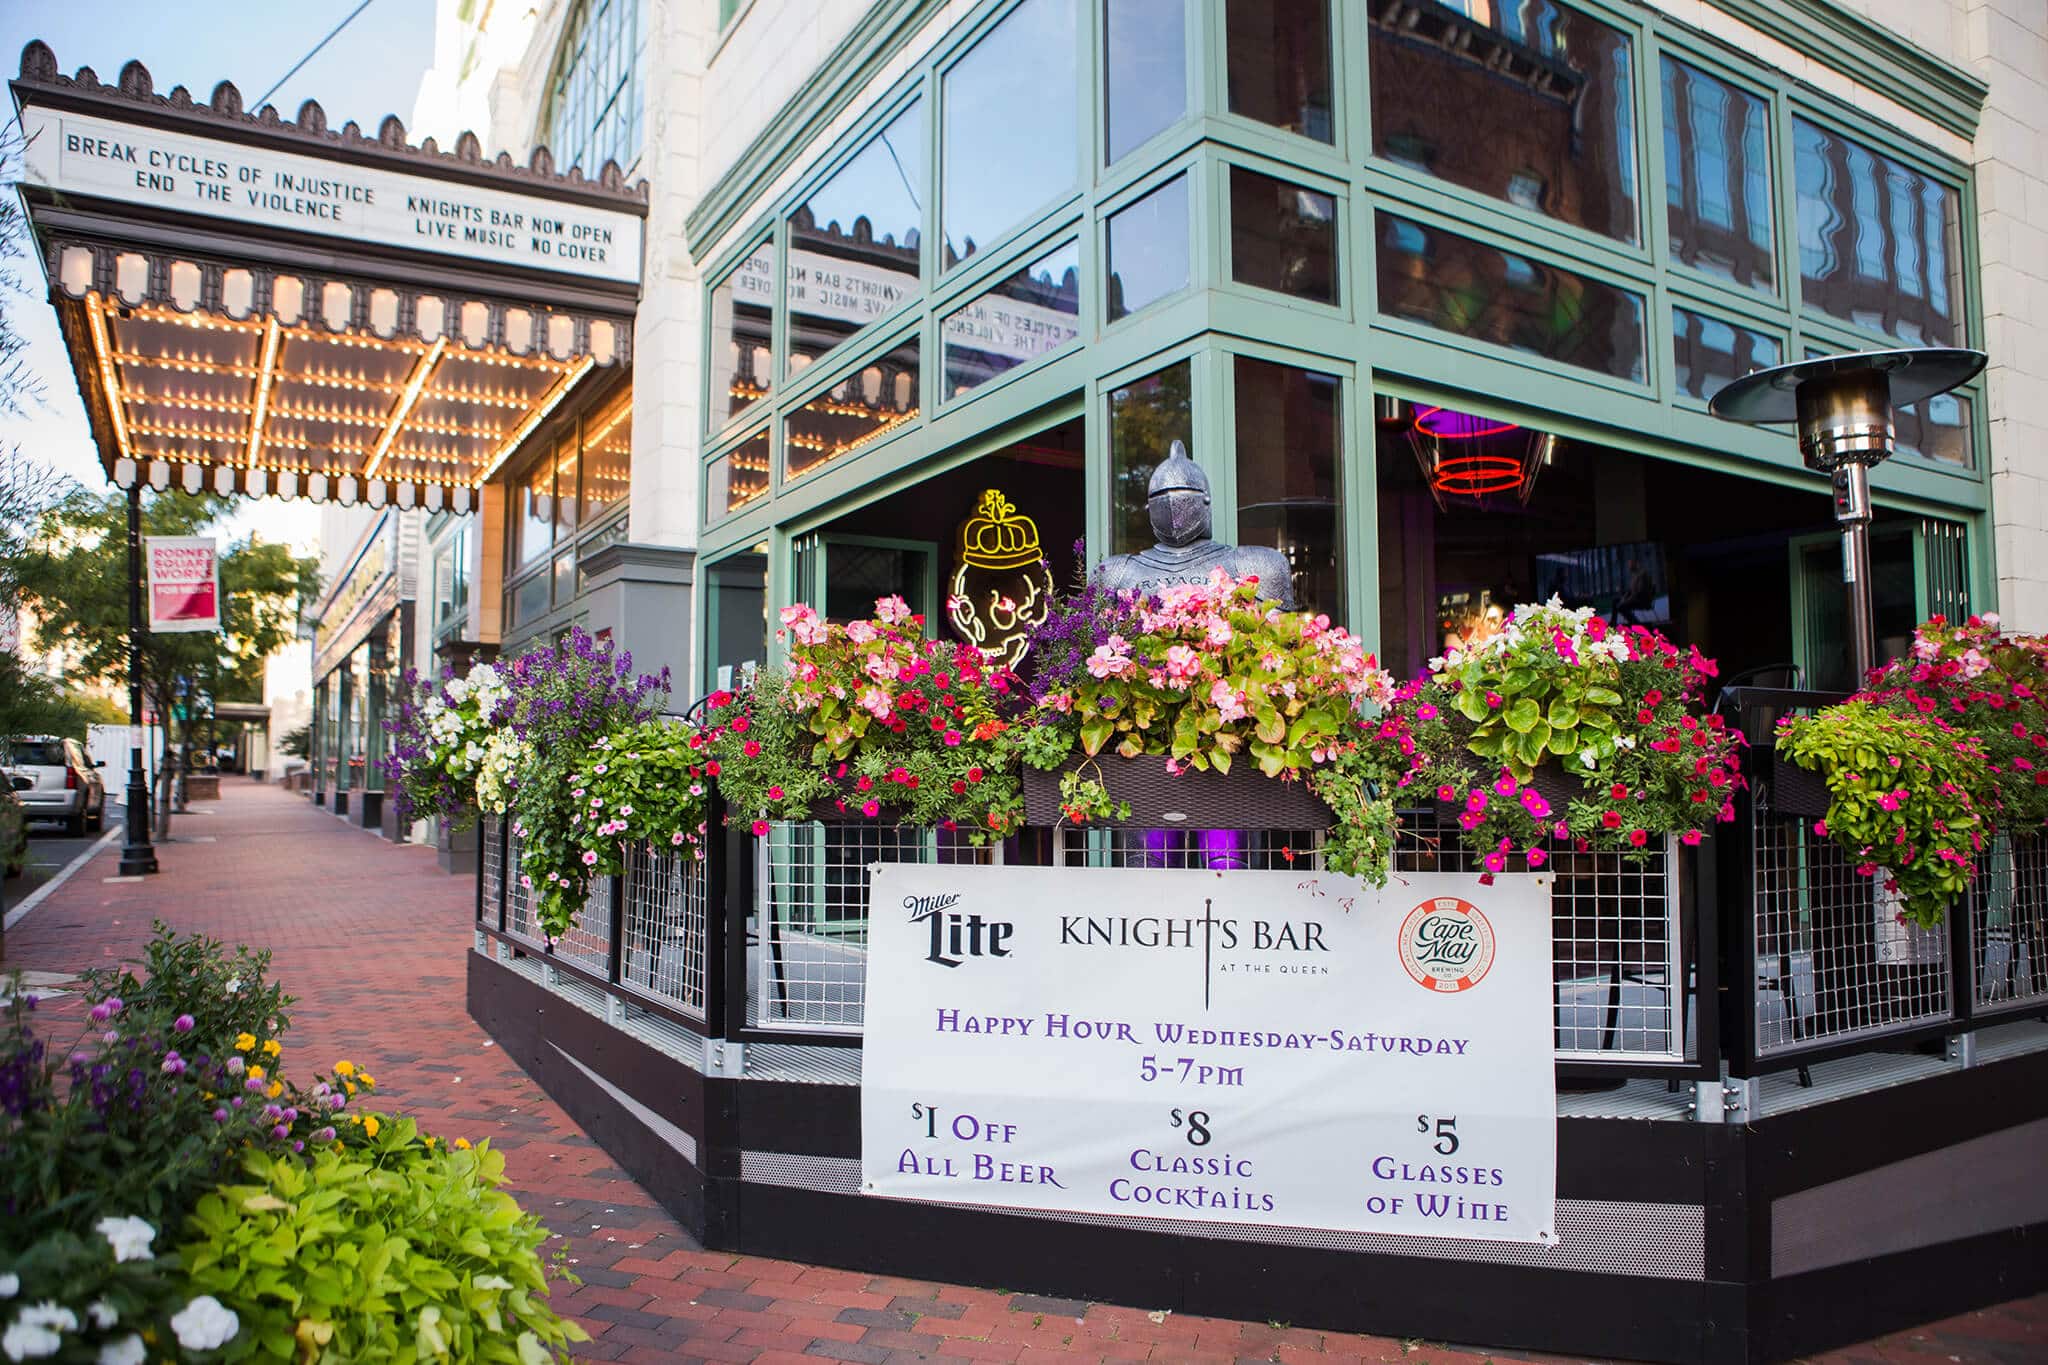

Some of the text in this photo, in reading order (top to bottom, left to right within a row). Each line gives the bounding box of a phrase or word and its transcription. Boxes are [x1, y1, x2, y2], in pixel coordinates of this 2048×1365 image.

[67, 134, 375, 204] BREAK CYCLES OF INJUSTICE
[136, 171, 342, 220] END THE VIOLENCE
[407, 195, 612, 244] KNIGHTS BAR NOW OPEN
[416, 219, 606, 263] LIVE MUSIC NO COVER
[903, 894, 961, 918] Miller
[924, 911, 1013, 968] Lite
[1059, 914, 1331, 952] KNIGHTS BAR
[1419, 916, 1475, 942] Cape
[1220, 964, 1329, 976] AT THE QUEEN
[1414, 940, 1478, 965] May
[911, 1102, 939, 1139] $1
[1171, 1108, 1212, 1146] $8
[1417, 1115, 1459, 1155] $5
